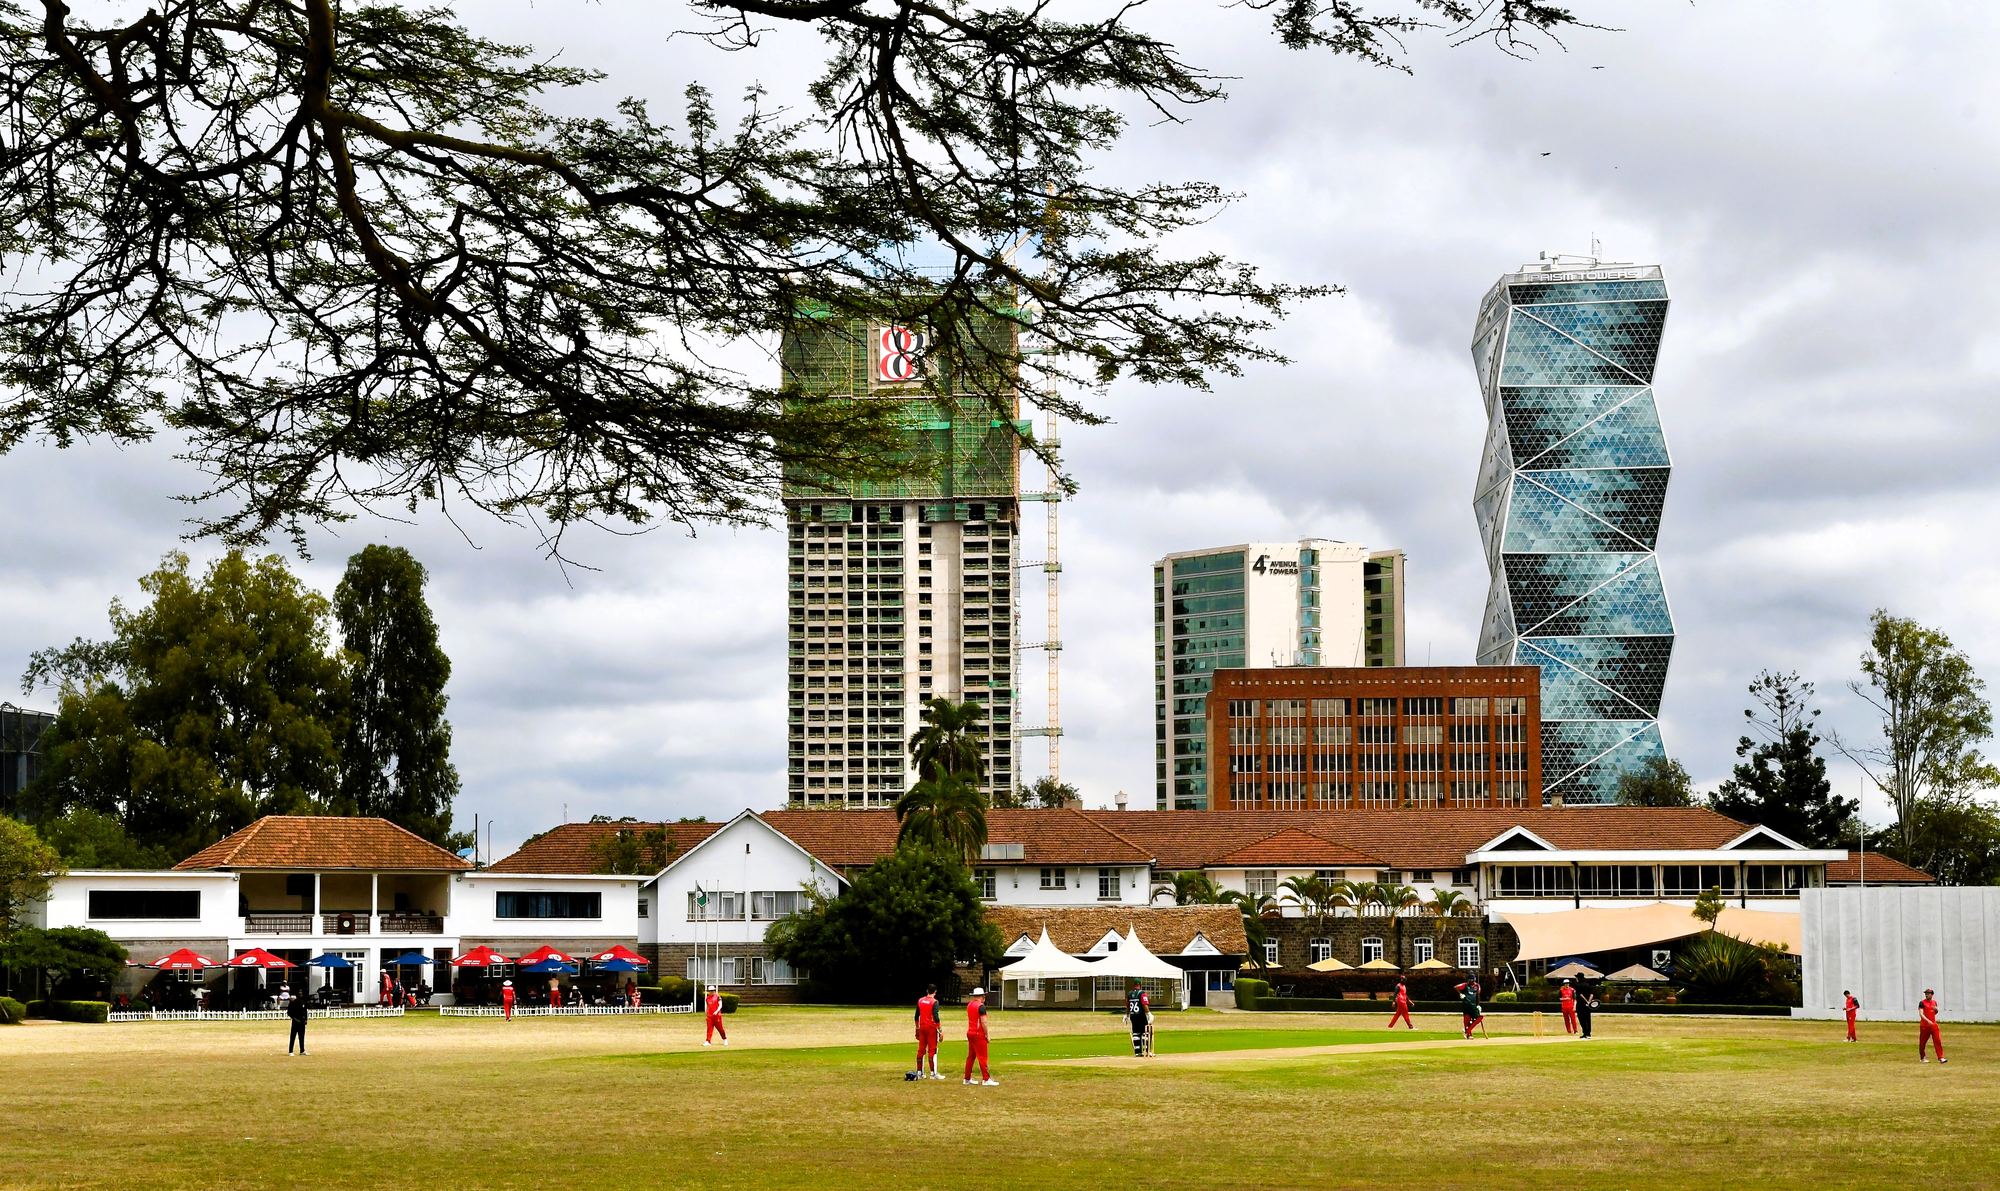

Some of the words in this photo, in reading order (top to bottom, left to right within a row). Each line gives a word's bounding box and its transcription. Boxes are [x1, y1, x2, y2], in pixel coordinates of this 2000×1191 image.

[1530, 272, 1574, 282] PRISM
[1579, 270, 1638, 280] TOWERS
[1129, 1002, 1140, 1013] 96
